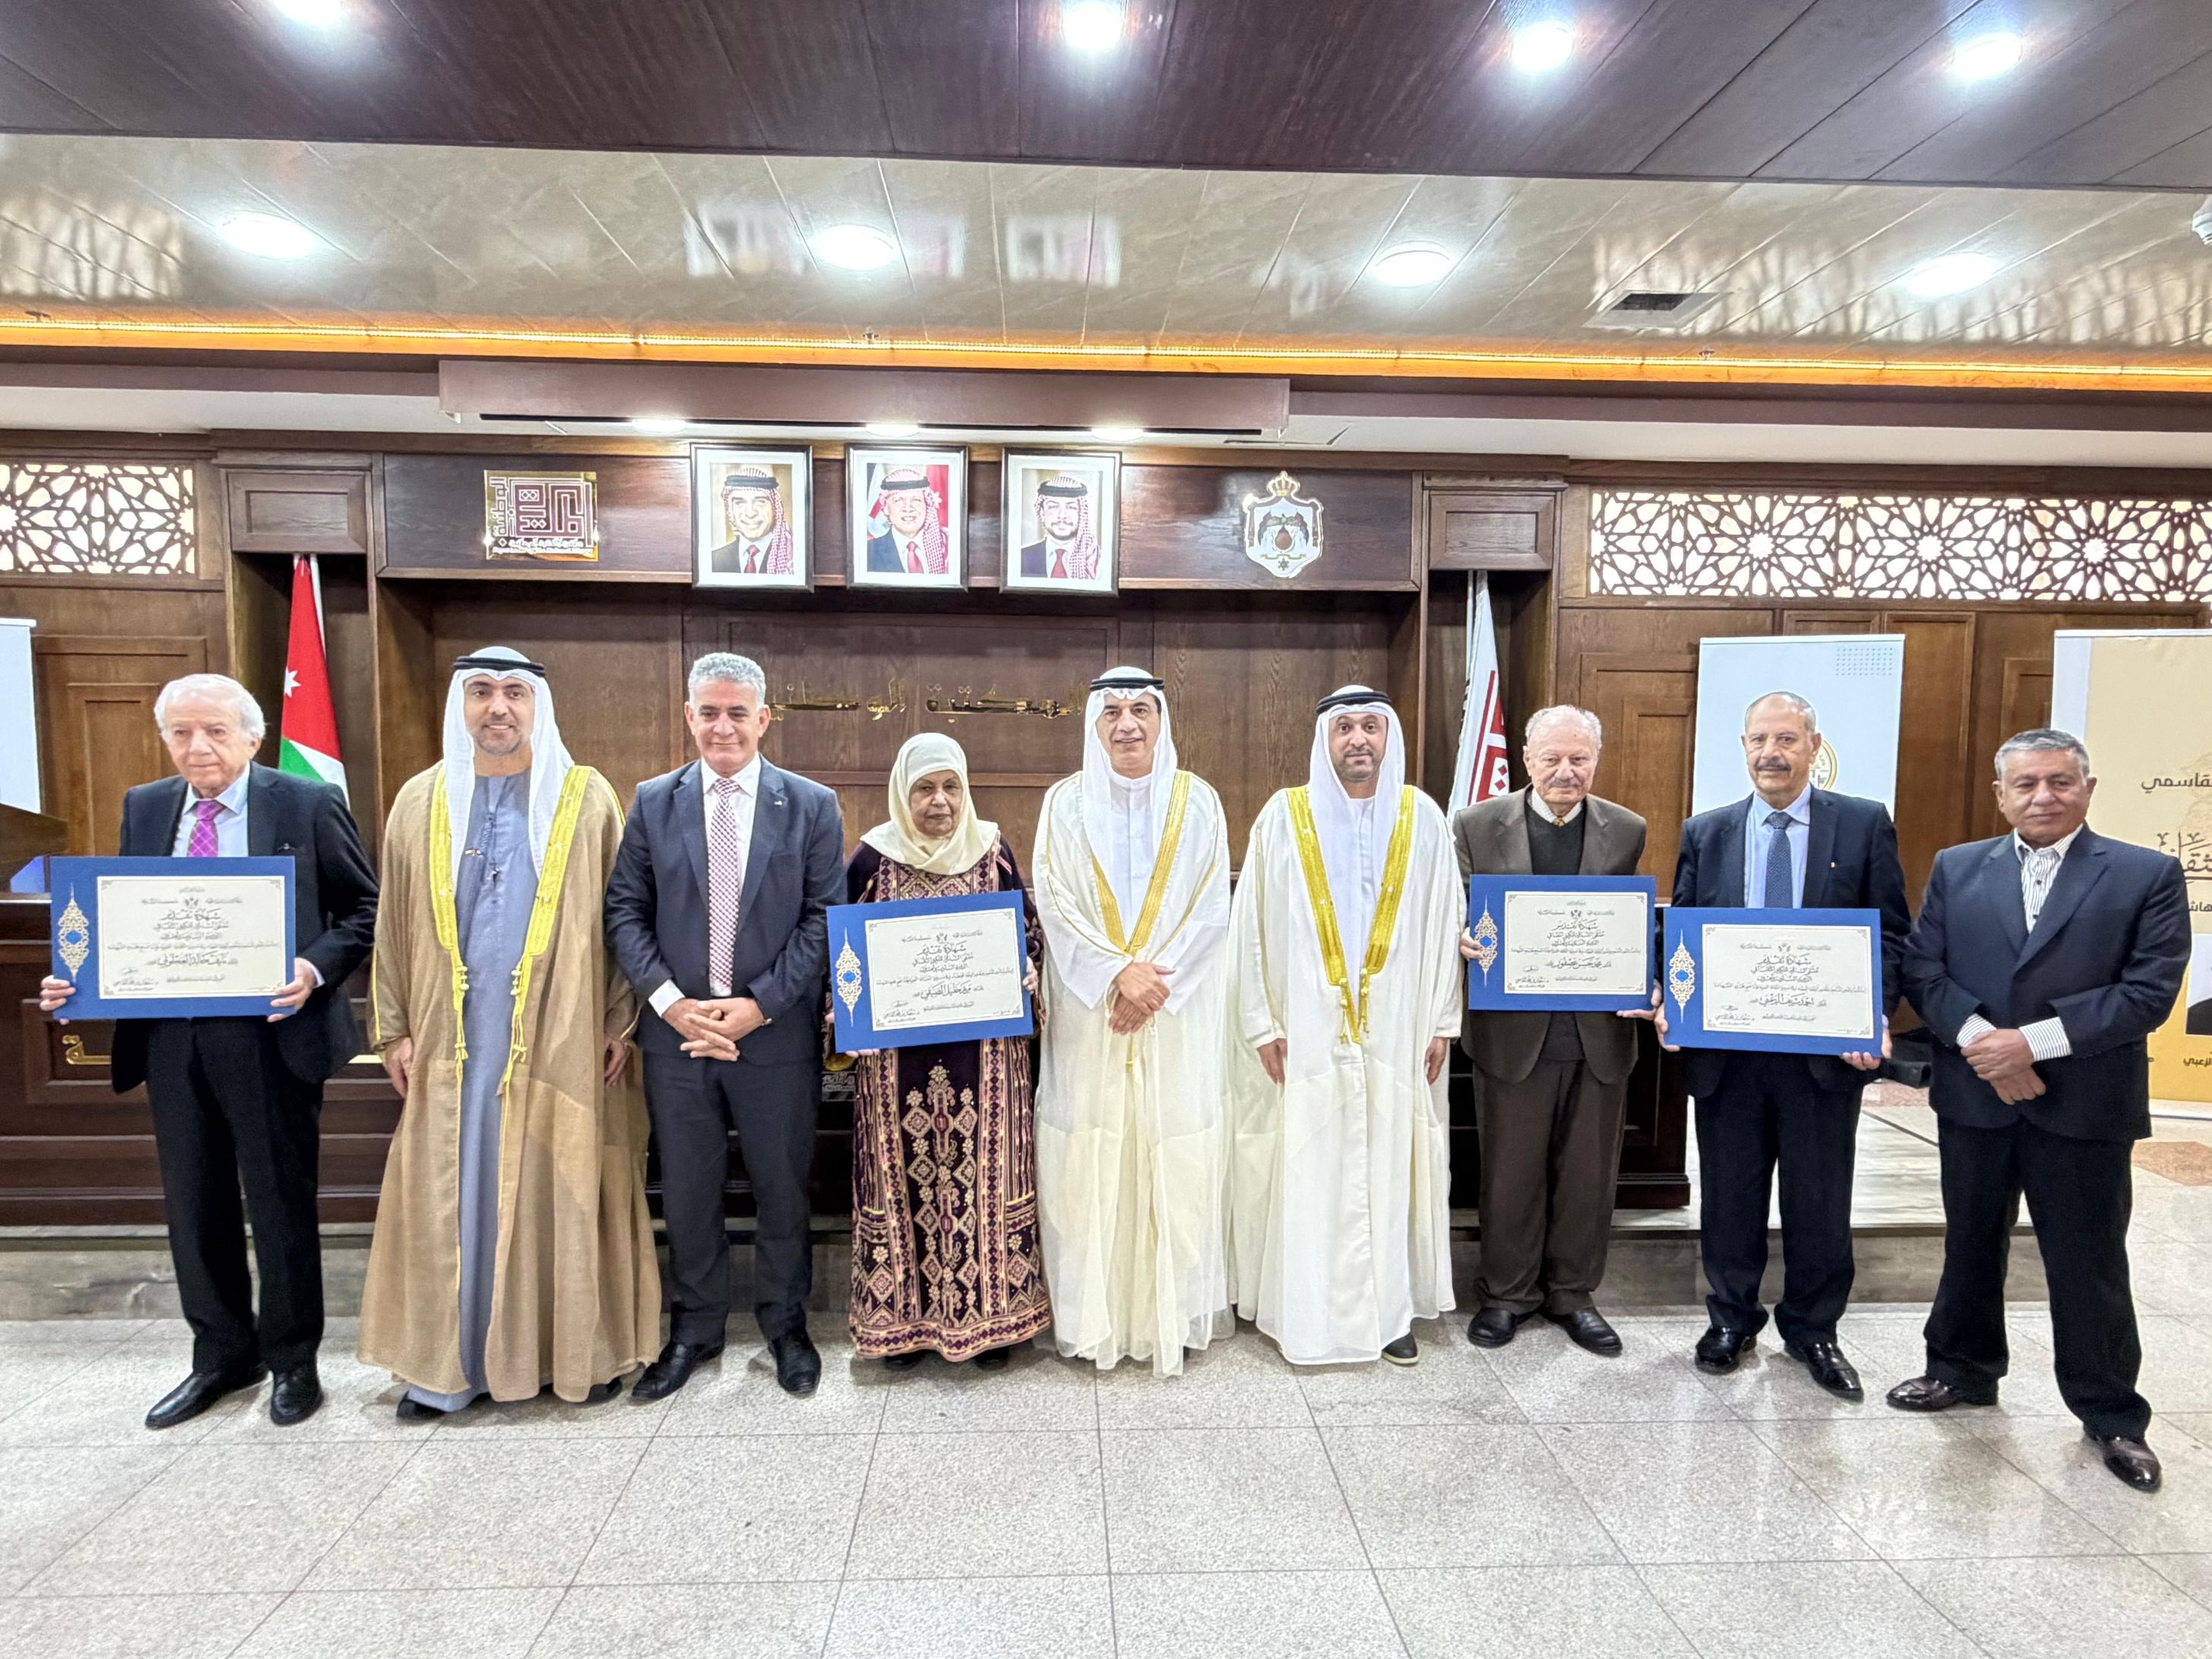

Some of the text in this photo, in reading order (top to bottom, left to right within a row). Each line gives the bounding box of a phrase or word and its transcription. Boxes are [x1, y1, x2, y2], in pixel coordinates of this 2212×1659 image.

[768, 676, 908, 722] الوطني
[2141, 773, 2212, 794] قاسمي
[2182, 1057, 2212, 1068] لزعبي
